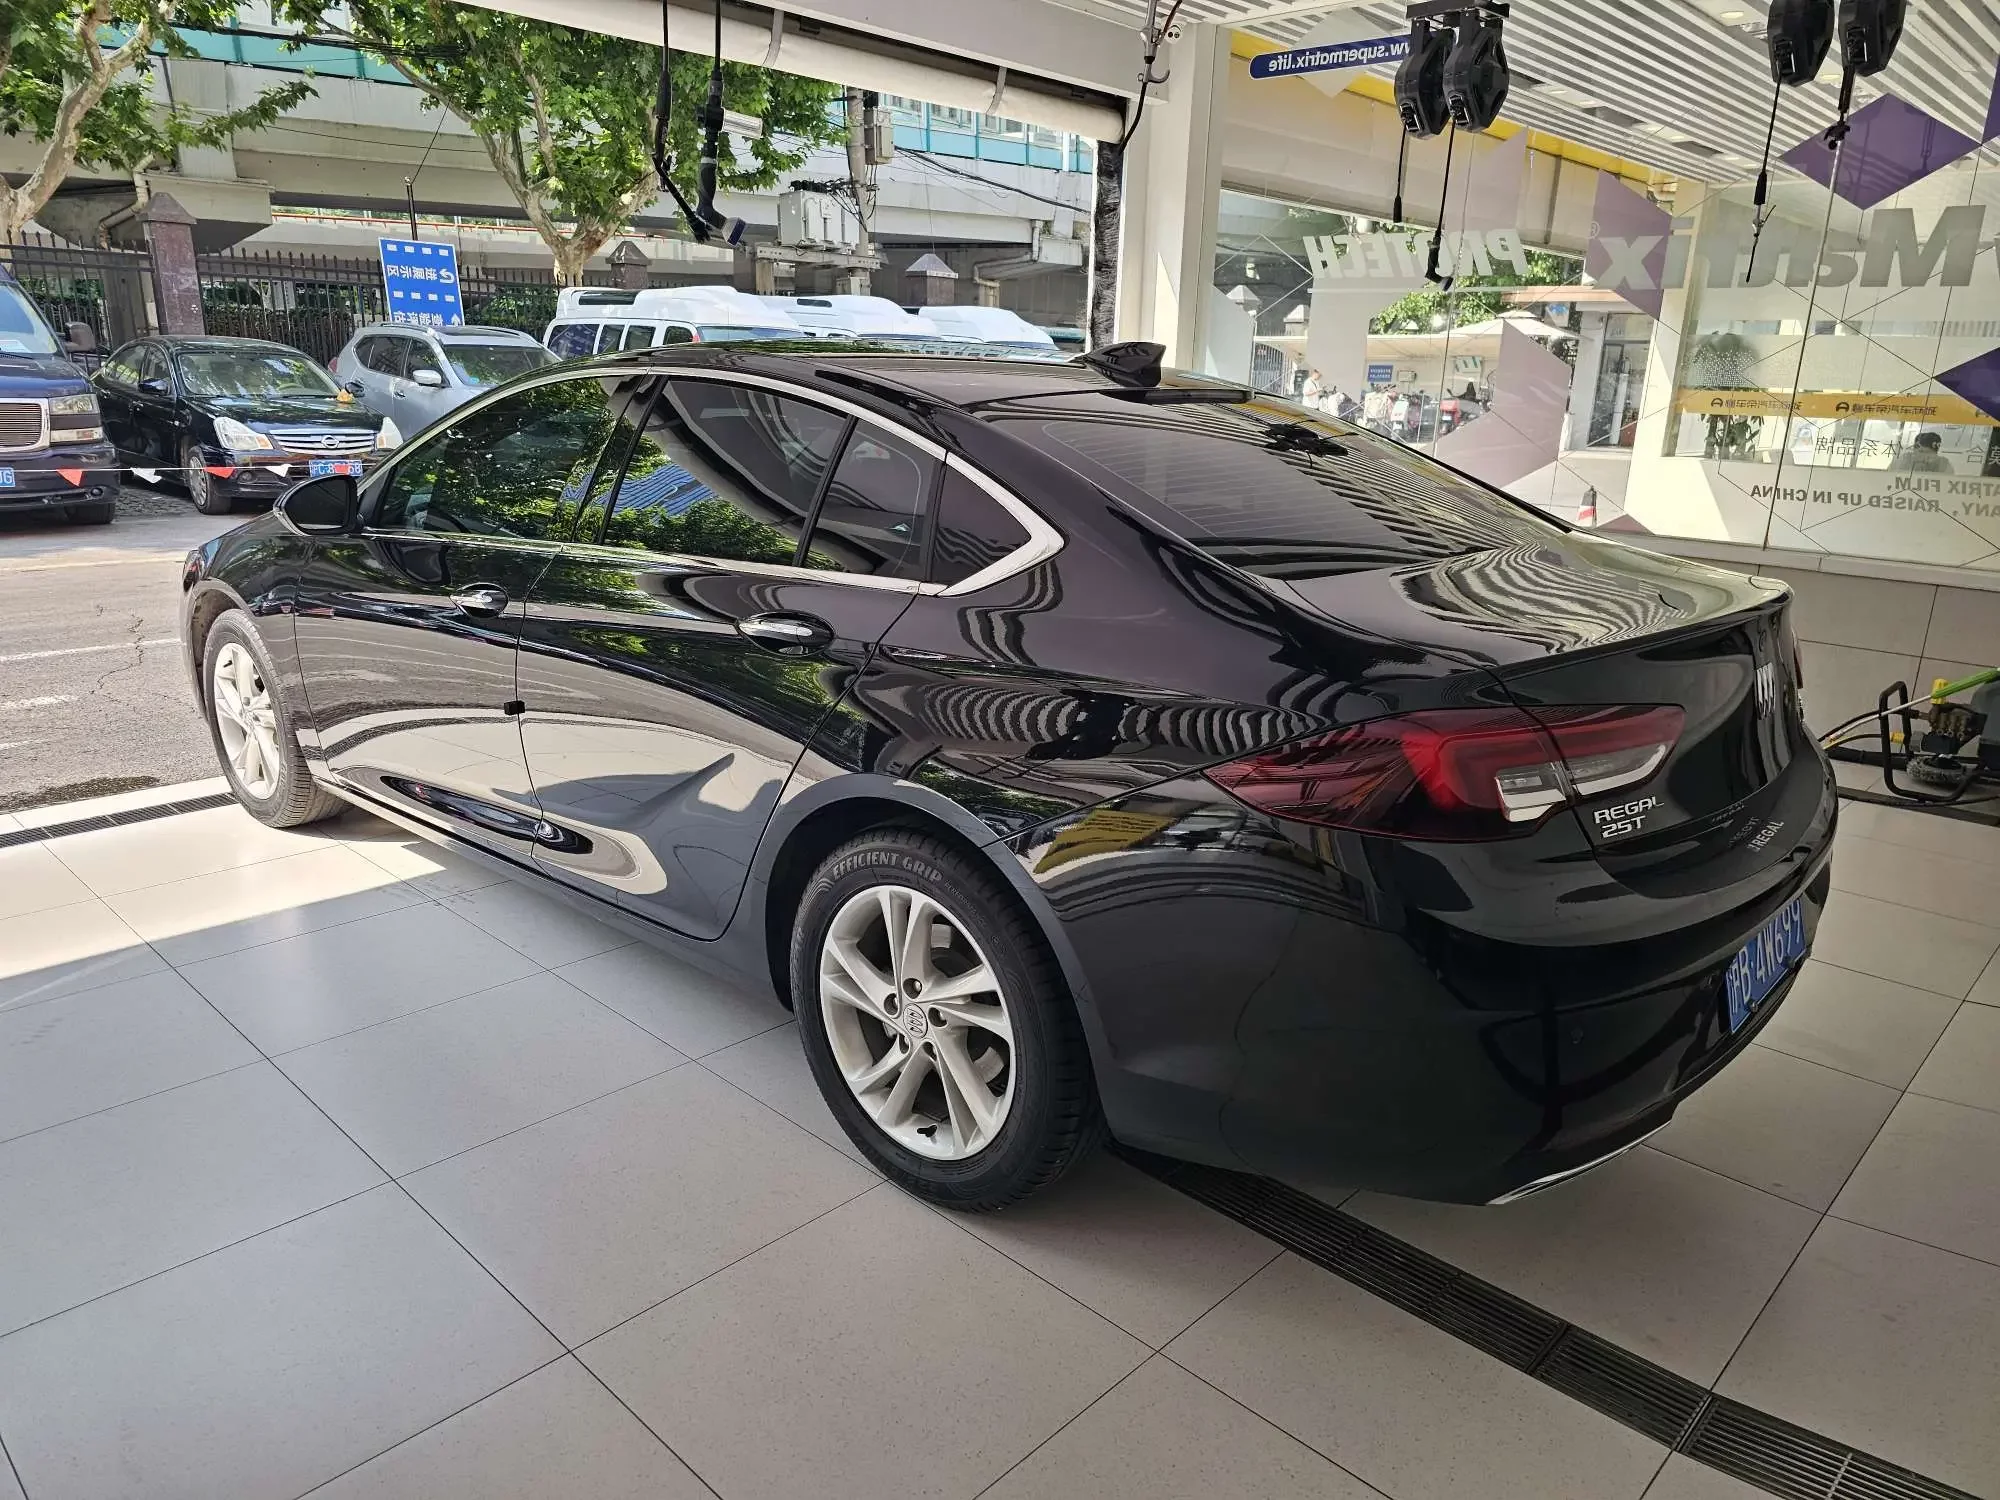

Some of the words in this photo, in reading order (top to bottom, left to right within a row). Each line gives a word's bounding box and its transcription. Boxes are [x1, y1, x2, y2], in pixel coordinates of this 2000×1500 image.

[386, 264, 438, 281] 进展示区
[1594, 796, 1665, 824] REGAL
[1601, 815, 1646, 838] 25T
[832, 851, 900, 880] EFFICIENT
[902, 856, 944, 882] GRIP
